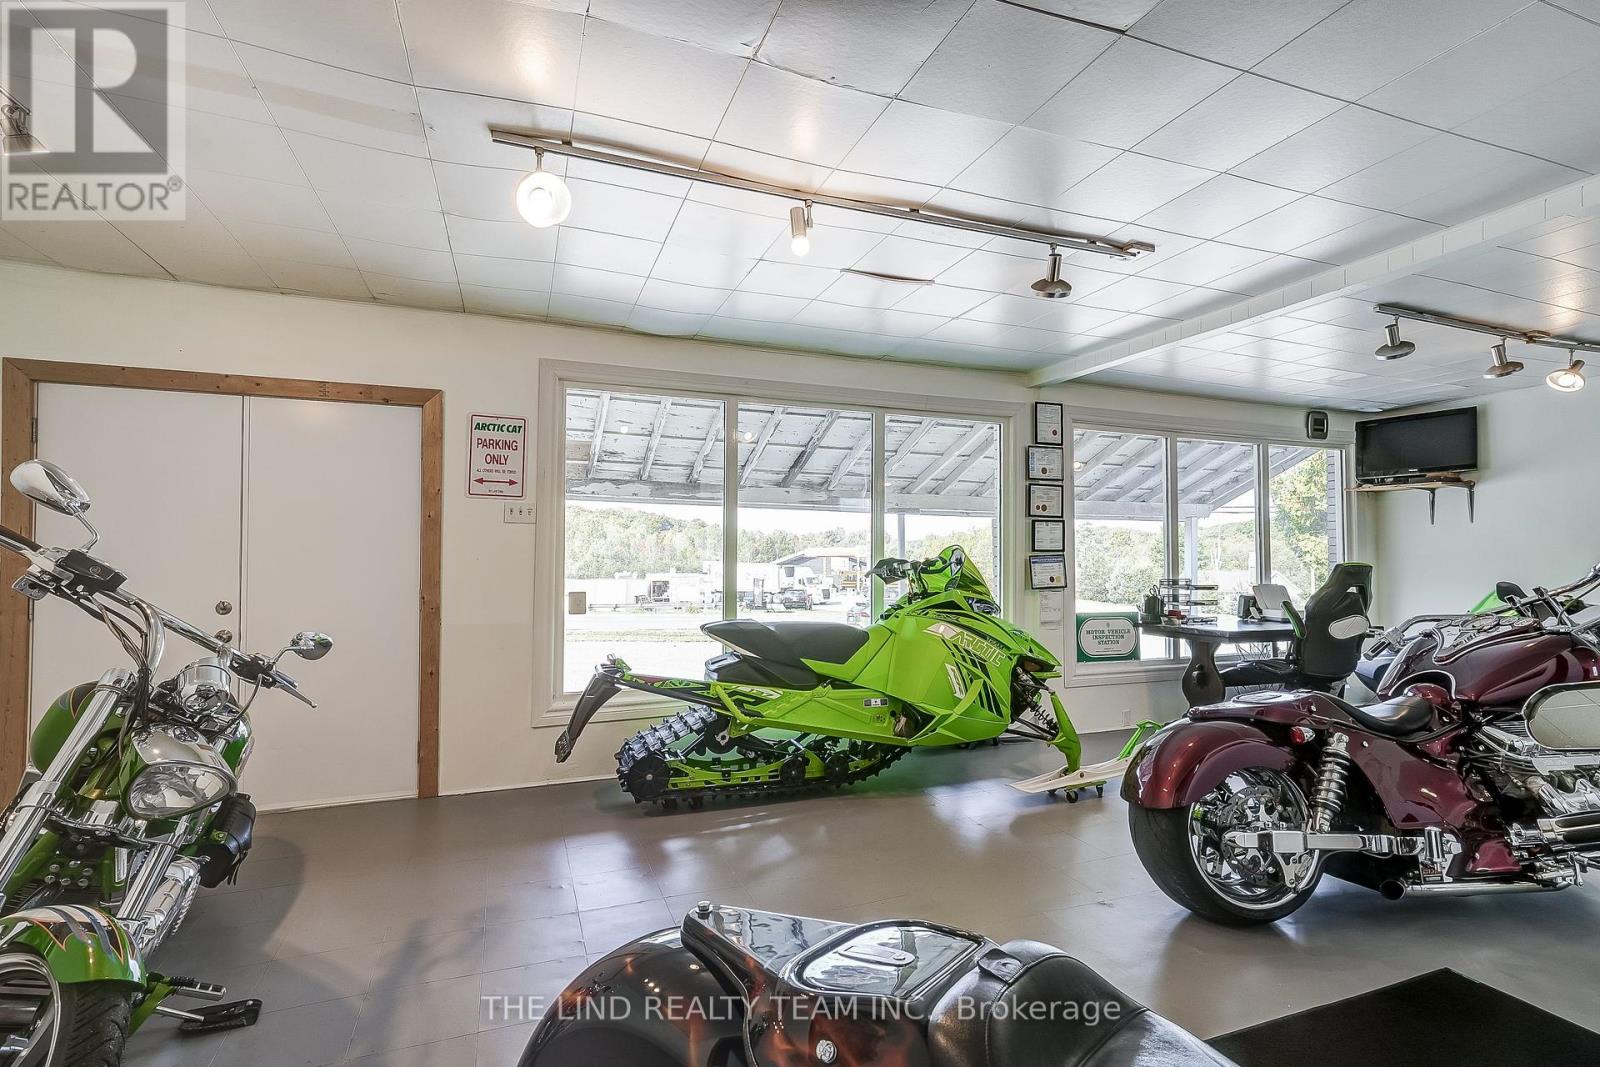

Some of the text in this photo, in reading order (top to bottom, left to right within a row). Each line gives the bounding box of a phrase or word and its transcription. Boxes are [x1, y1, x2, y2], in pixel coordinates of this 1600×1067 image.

[474, 422, 523, 434] ARCTIC CAT
[476, 437, 518, 451] PARKING
[484, 453, 509, 466] ONLY
